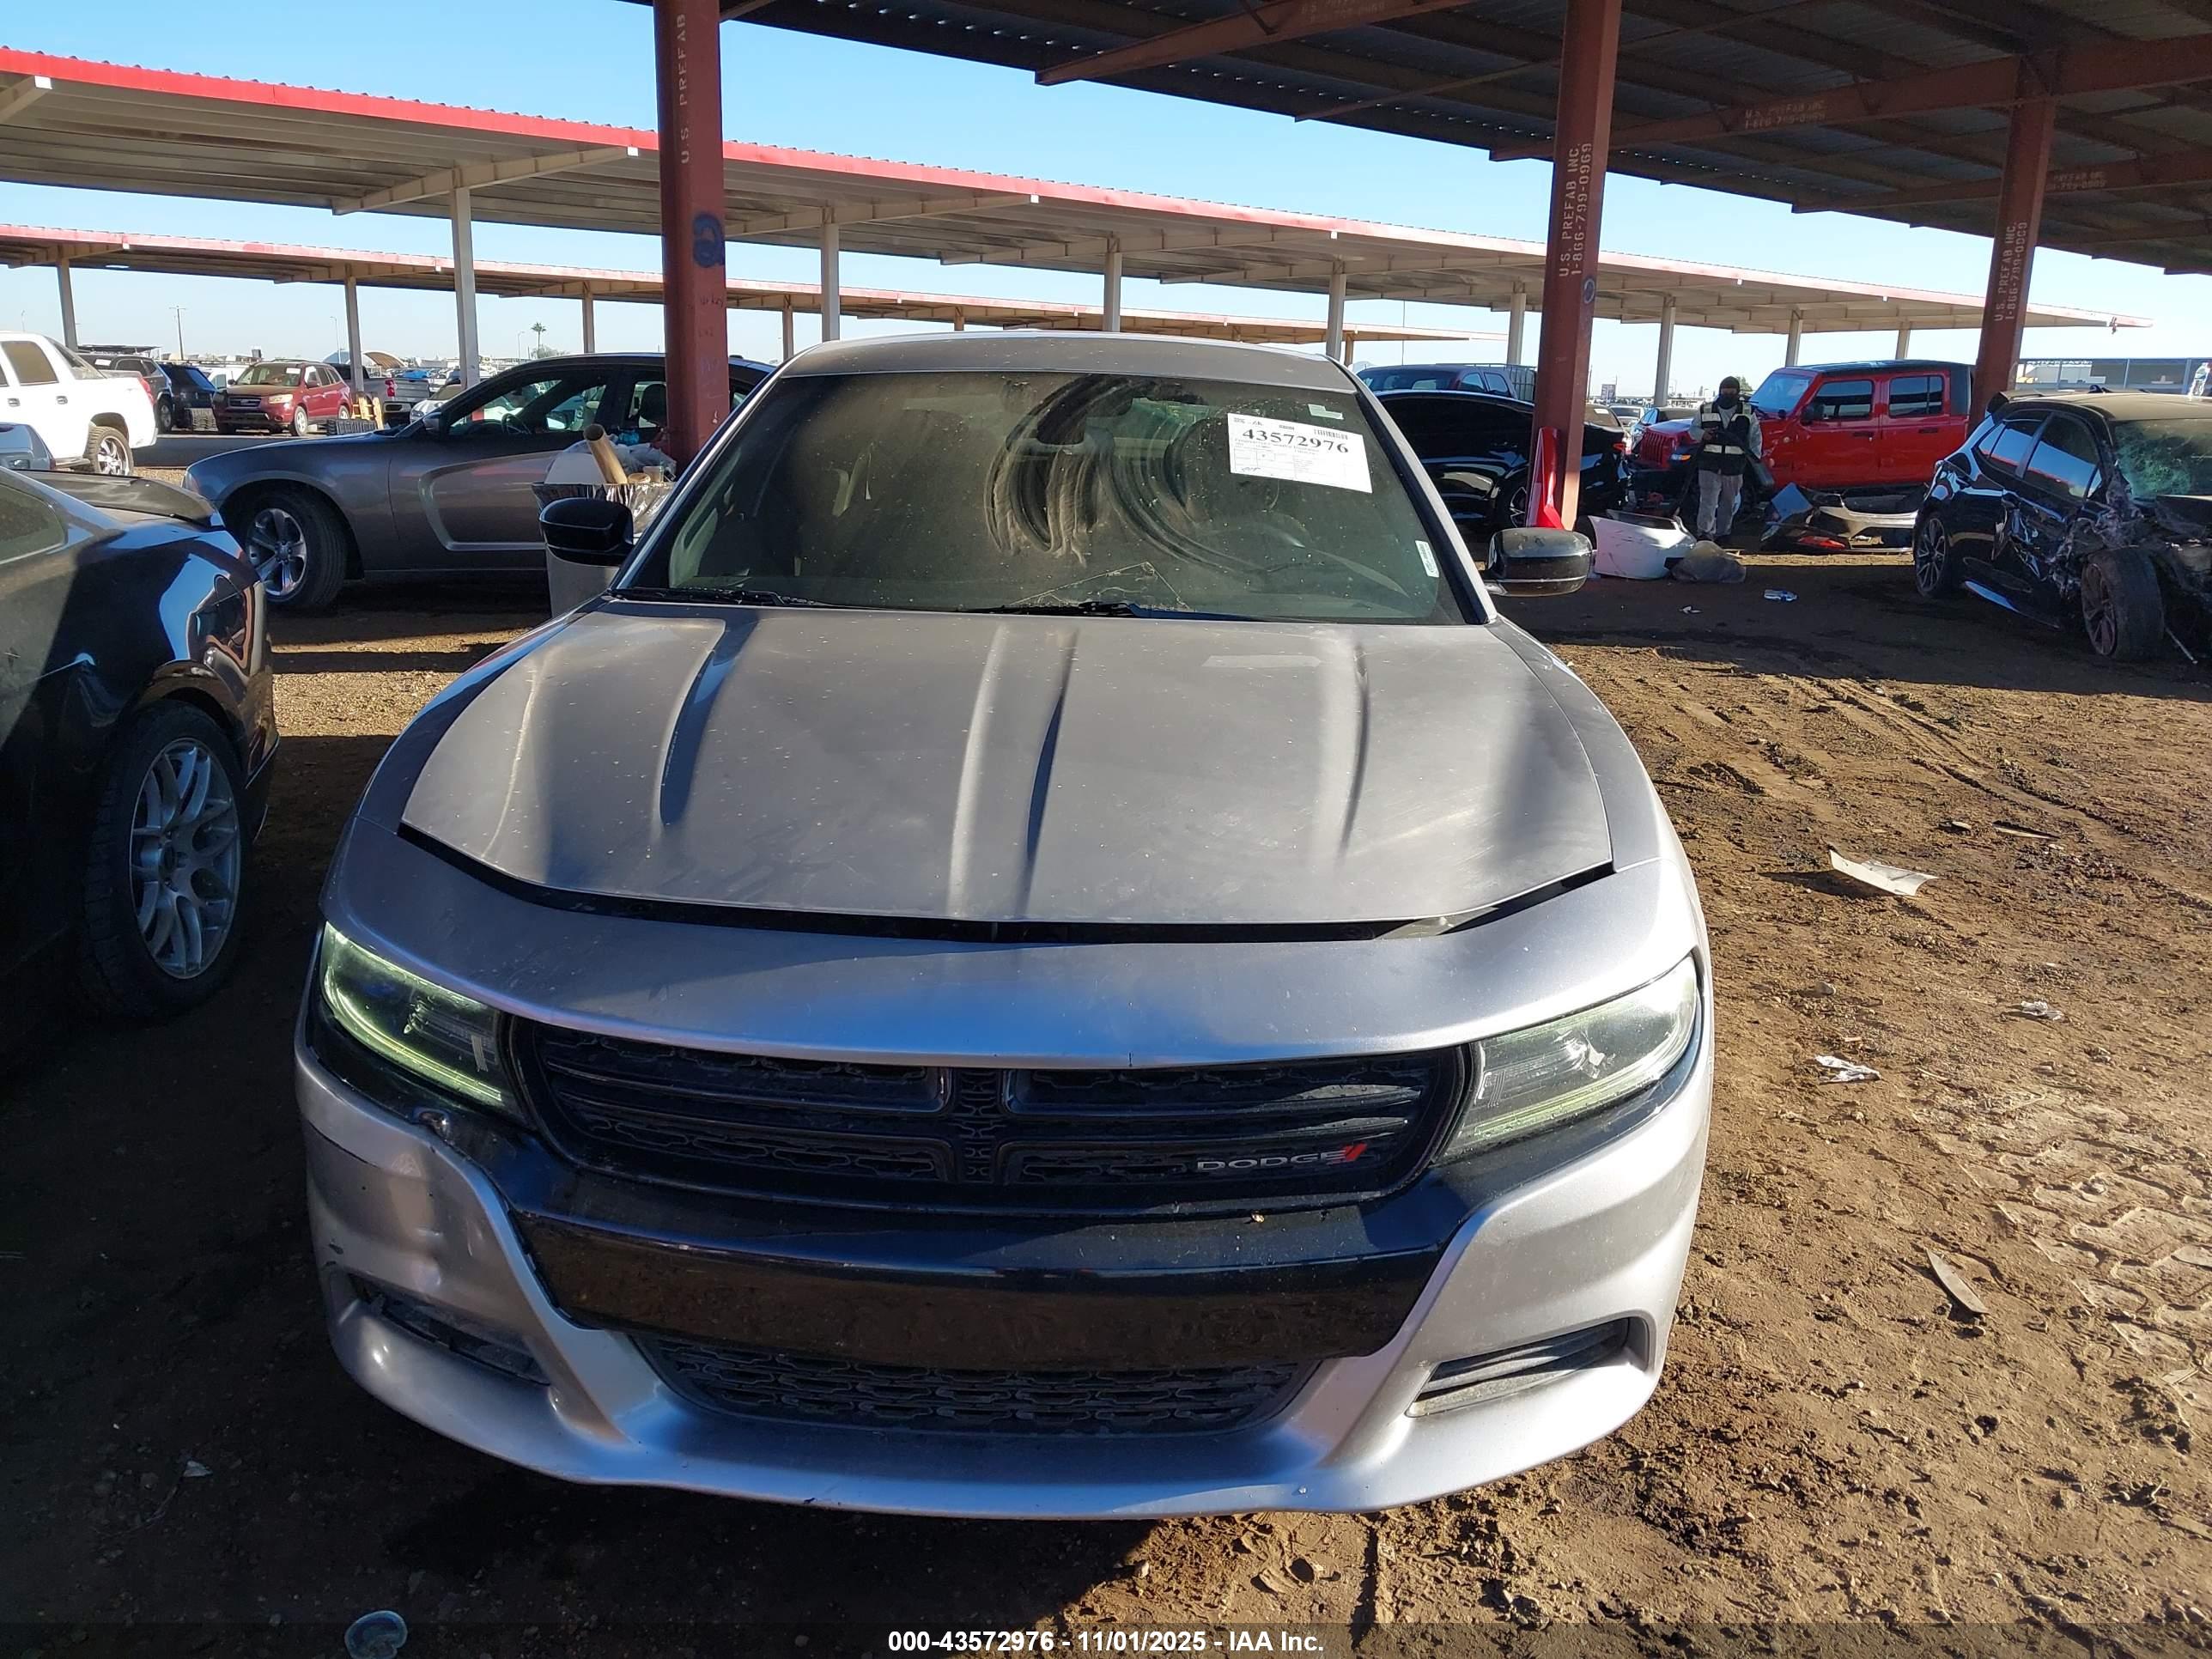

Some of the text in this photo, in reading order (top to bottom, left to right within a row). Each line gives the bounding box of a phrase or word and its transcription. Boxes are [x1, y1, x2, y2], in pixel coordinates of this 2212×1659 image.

[677, 14, 688, 106] PREFAB
[1559, 143, 1580, 276] U.S. PREFAB INC.
[1571, 143, 1592, 276] 1-866-799-0969
[1997, 249, 2013, 294] PREFAB
[1243, 428, 1349, 453] 43572976
[1197, 1150, 1347, 1172] DODGE
